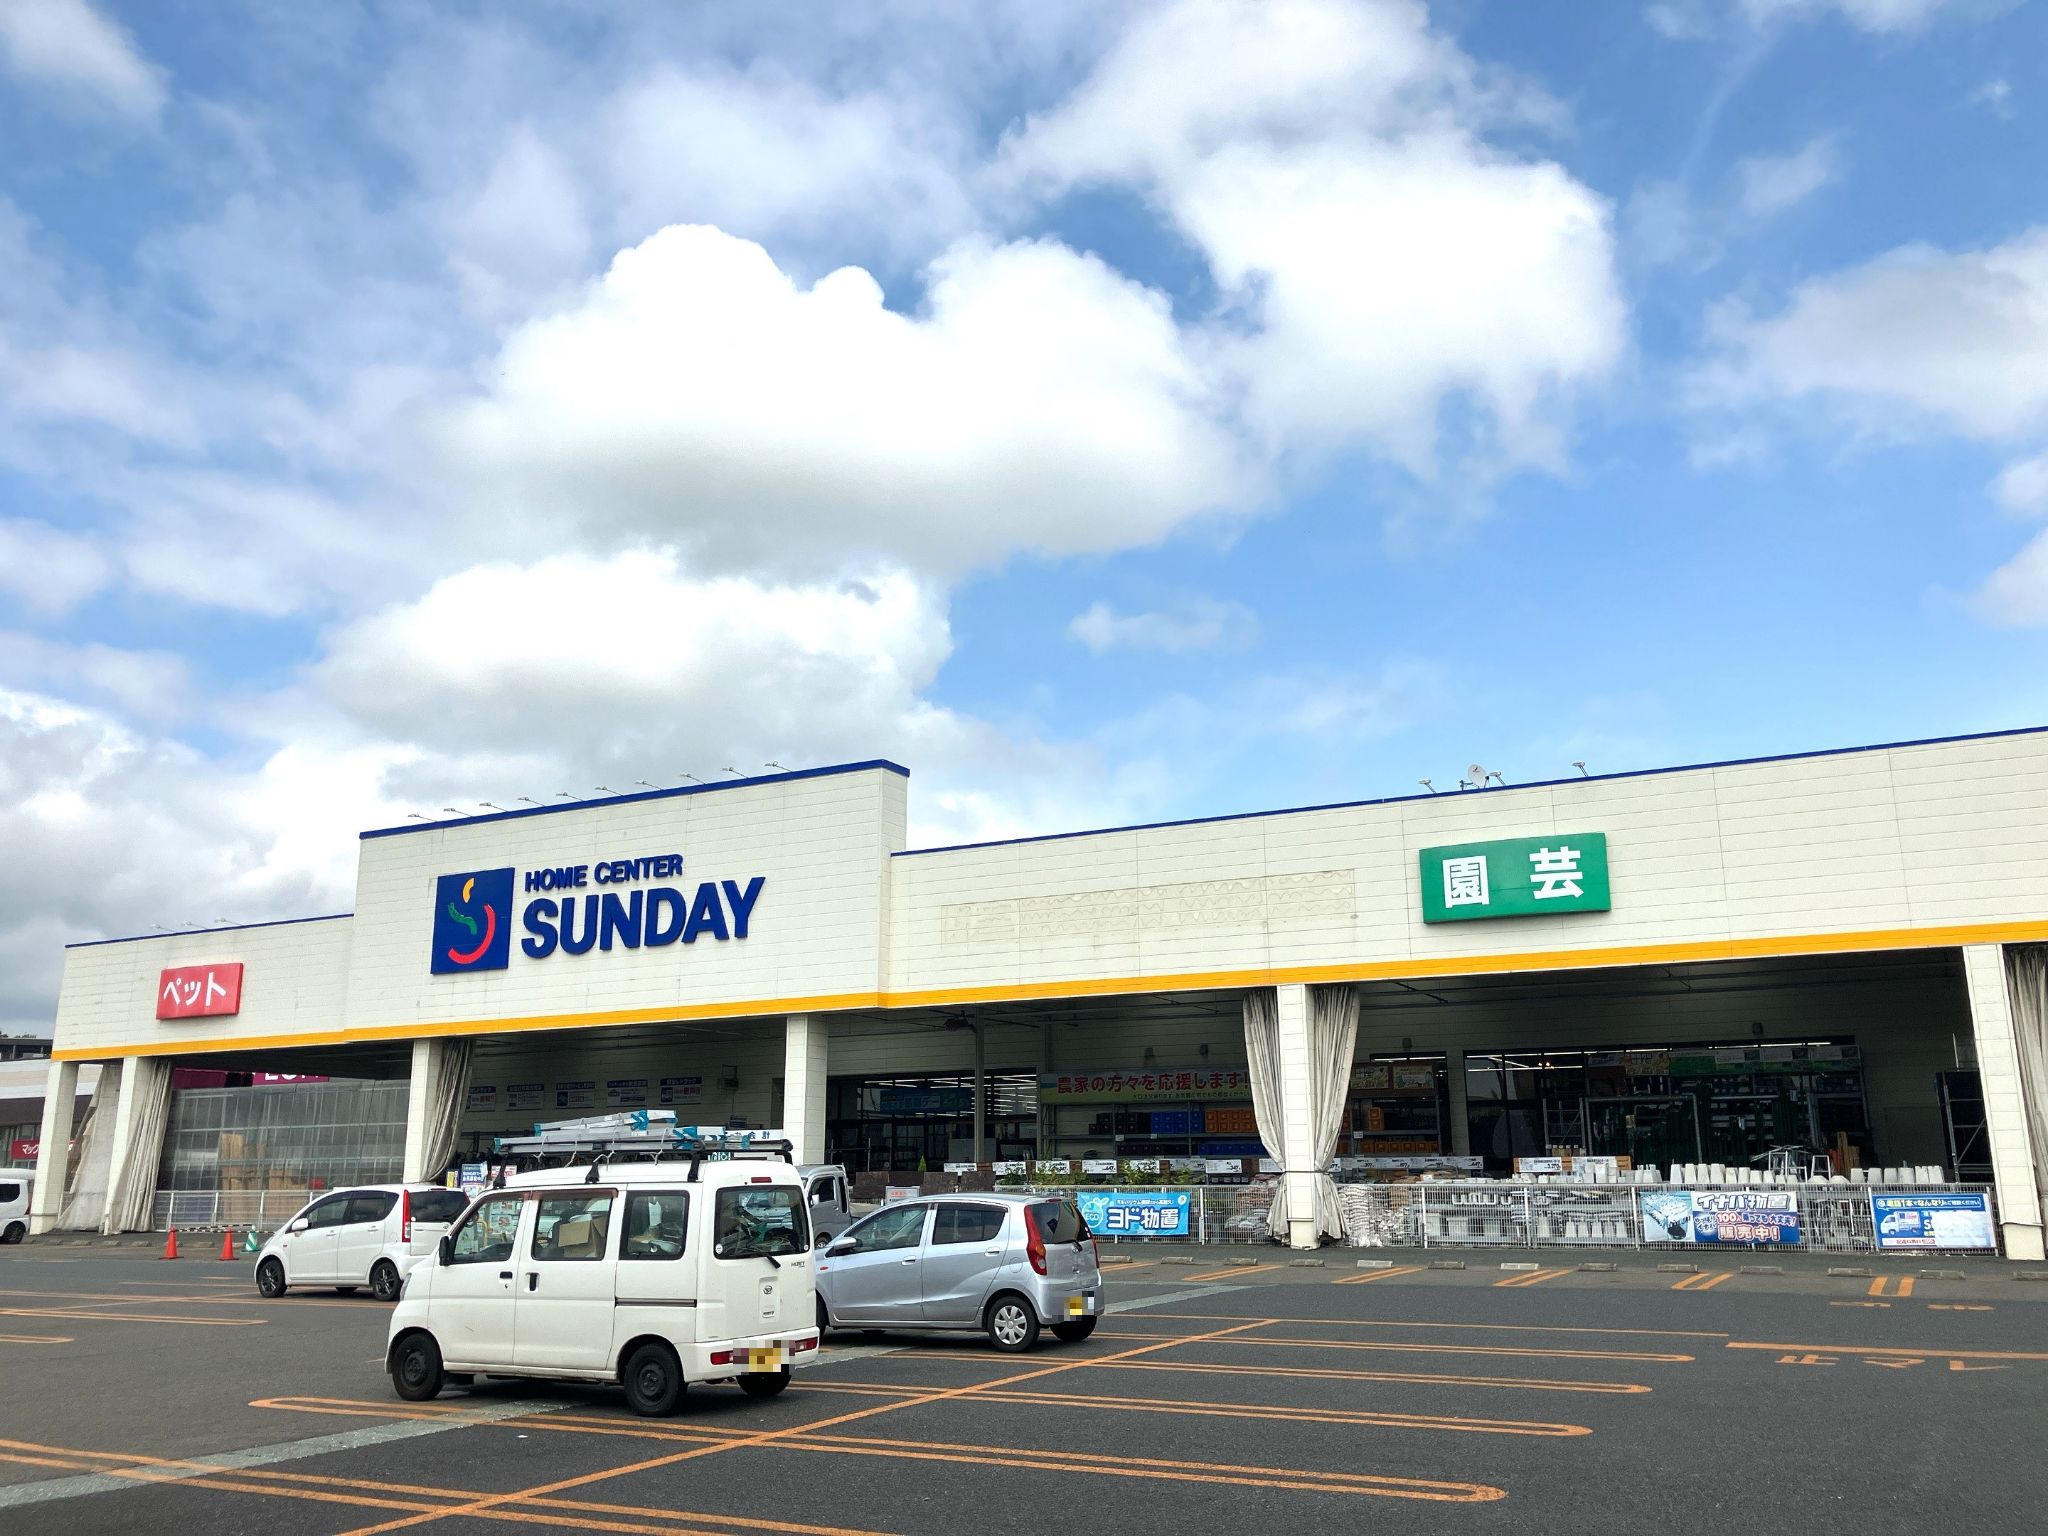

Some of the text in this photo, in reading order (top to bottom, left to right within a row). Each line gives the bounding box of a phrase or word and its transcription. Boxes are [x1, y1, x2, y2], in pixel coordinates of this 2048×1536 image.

[525, 853, 683, 892] HOME CENTER
[1442, 845, 1584, 908] 園芸
[521, 876, 766, 959] SUNDAY
[163, 972, 227, 1007] ペット
[1107, 1207, 1179, 1230] ヨド物置
[1697, 1193, 1790, 1210] イナバ物置
[1719, 1227, 1779, 1240] 販売中!
